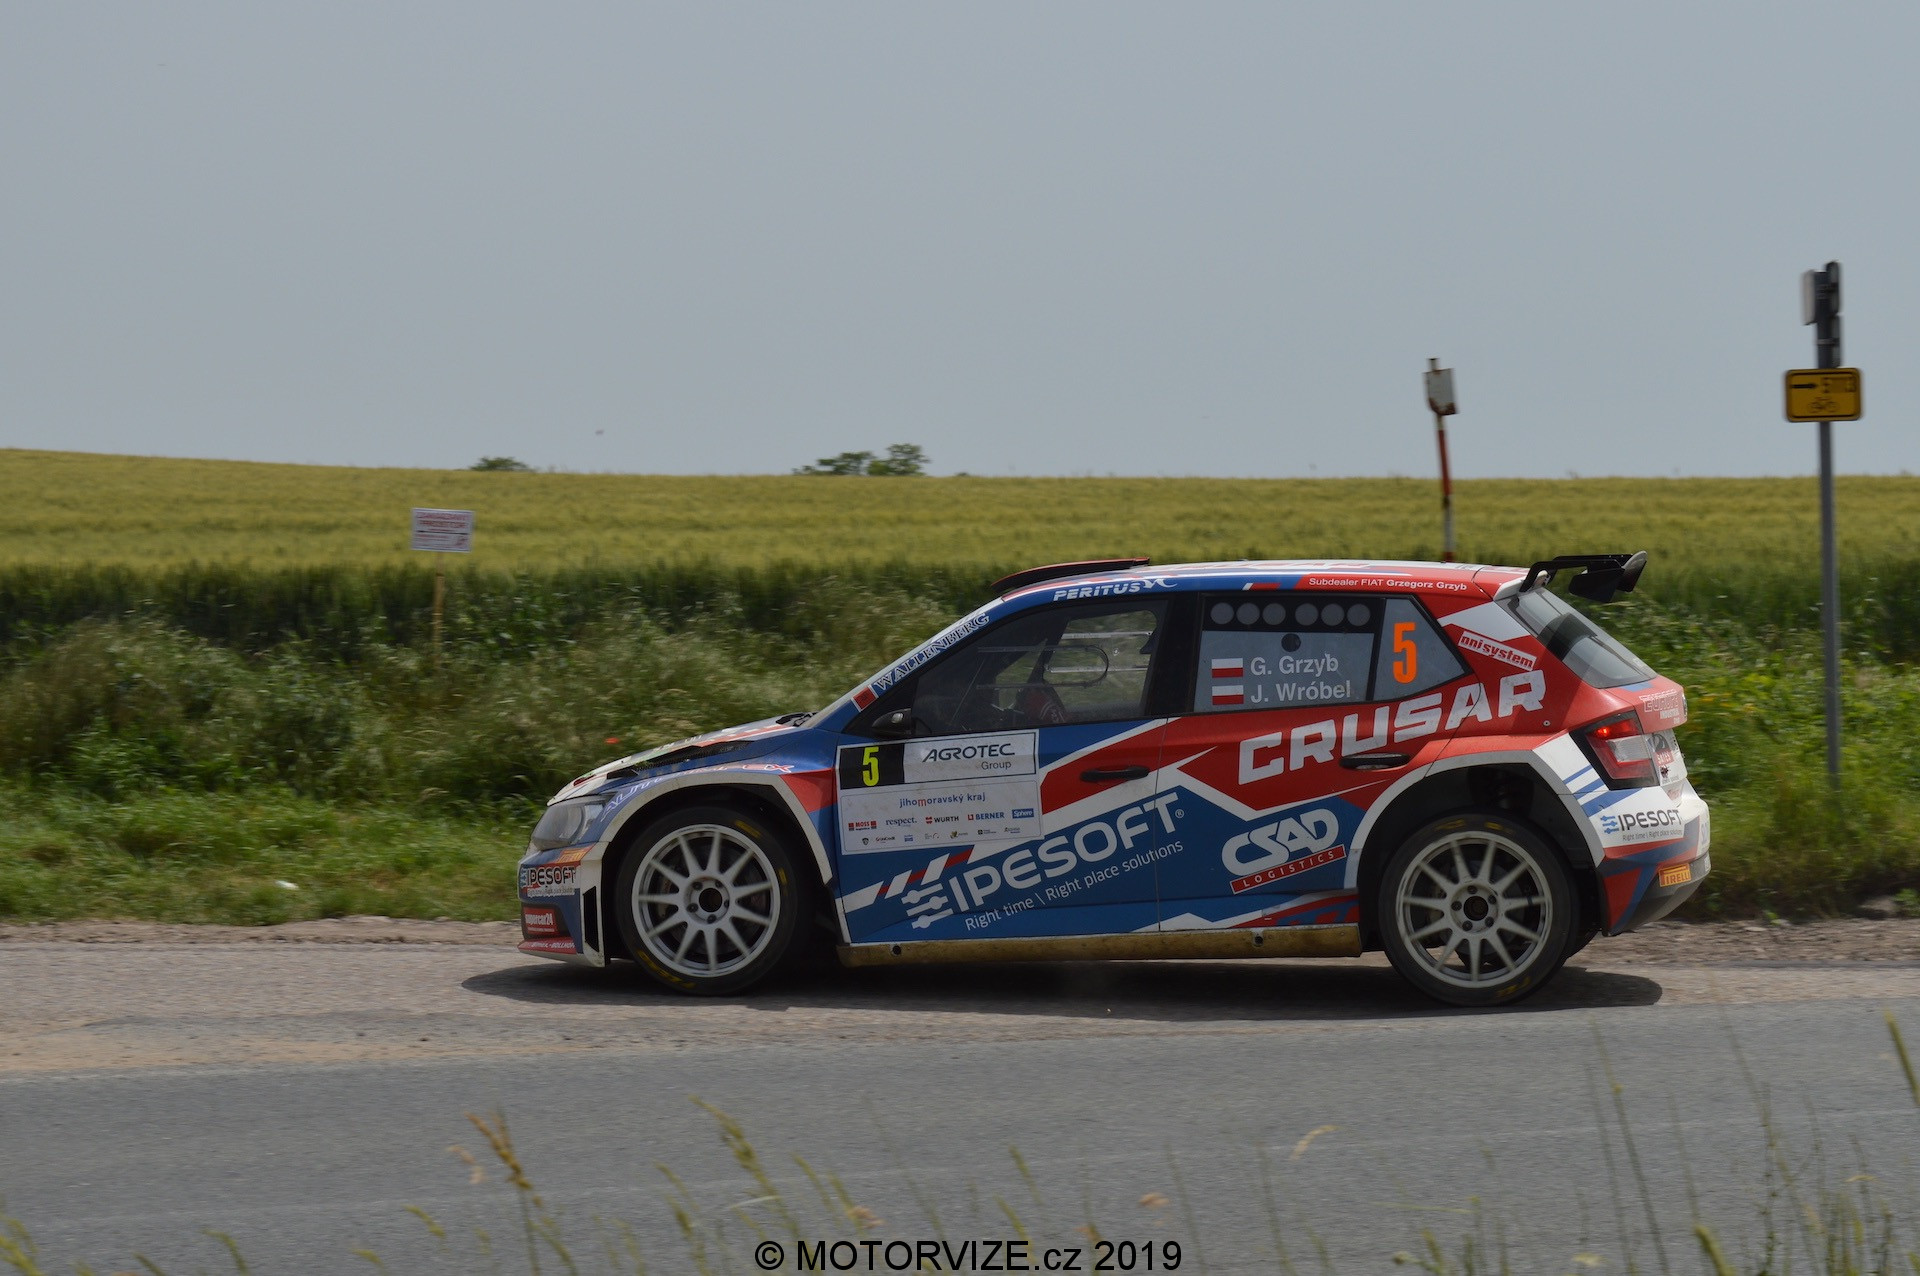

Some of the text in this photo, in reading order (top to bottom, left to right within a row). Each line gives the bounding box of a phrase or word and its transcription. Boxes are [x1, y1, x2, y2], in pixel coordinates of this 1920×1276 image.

[1053, 583, 1141, 601] PERITUS
[1309, 577, 1468, 591] Subdealer FIAT Grzegorz Grzyb
[872, 612, 990, 691] WALLENBERG
[1393, 621, 1418, 684] 5
[1250, 653, 1339, 677] G. Grzyb
[1250, 680, 1351, 703] J. Wróbel
[1238, 669, 1547, 785] CRUSAR
[922, 743, 1016, 762] AGROTEC
[862, 746, 880, 787] 5
[981, 761, 1012, 771] Group
[899, 792, 986, 808] jihomoravský kraj
[975, 812, 1005, 820] BERNER
[1618, 809, 1682, 831] IPESOFT
[948, 792, 1180, 913] IPESOFT
[1221, 808, 1340, 876] CSAD
[527, 866, 577, 886] IPESOFT
[1243, 851, 1335, 888] LOGISTICS
[965, 911, 1000, 931] Right
[1003, 897, 1035, 917] time
[1045, 880, 1082, 902] Right
[1083, 865, 1120, 889] place
[1122, 839, 1184, 873] solutions
